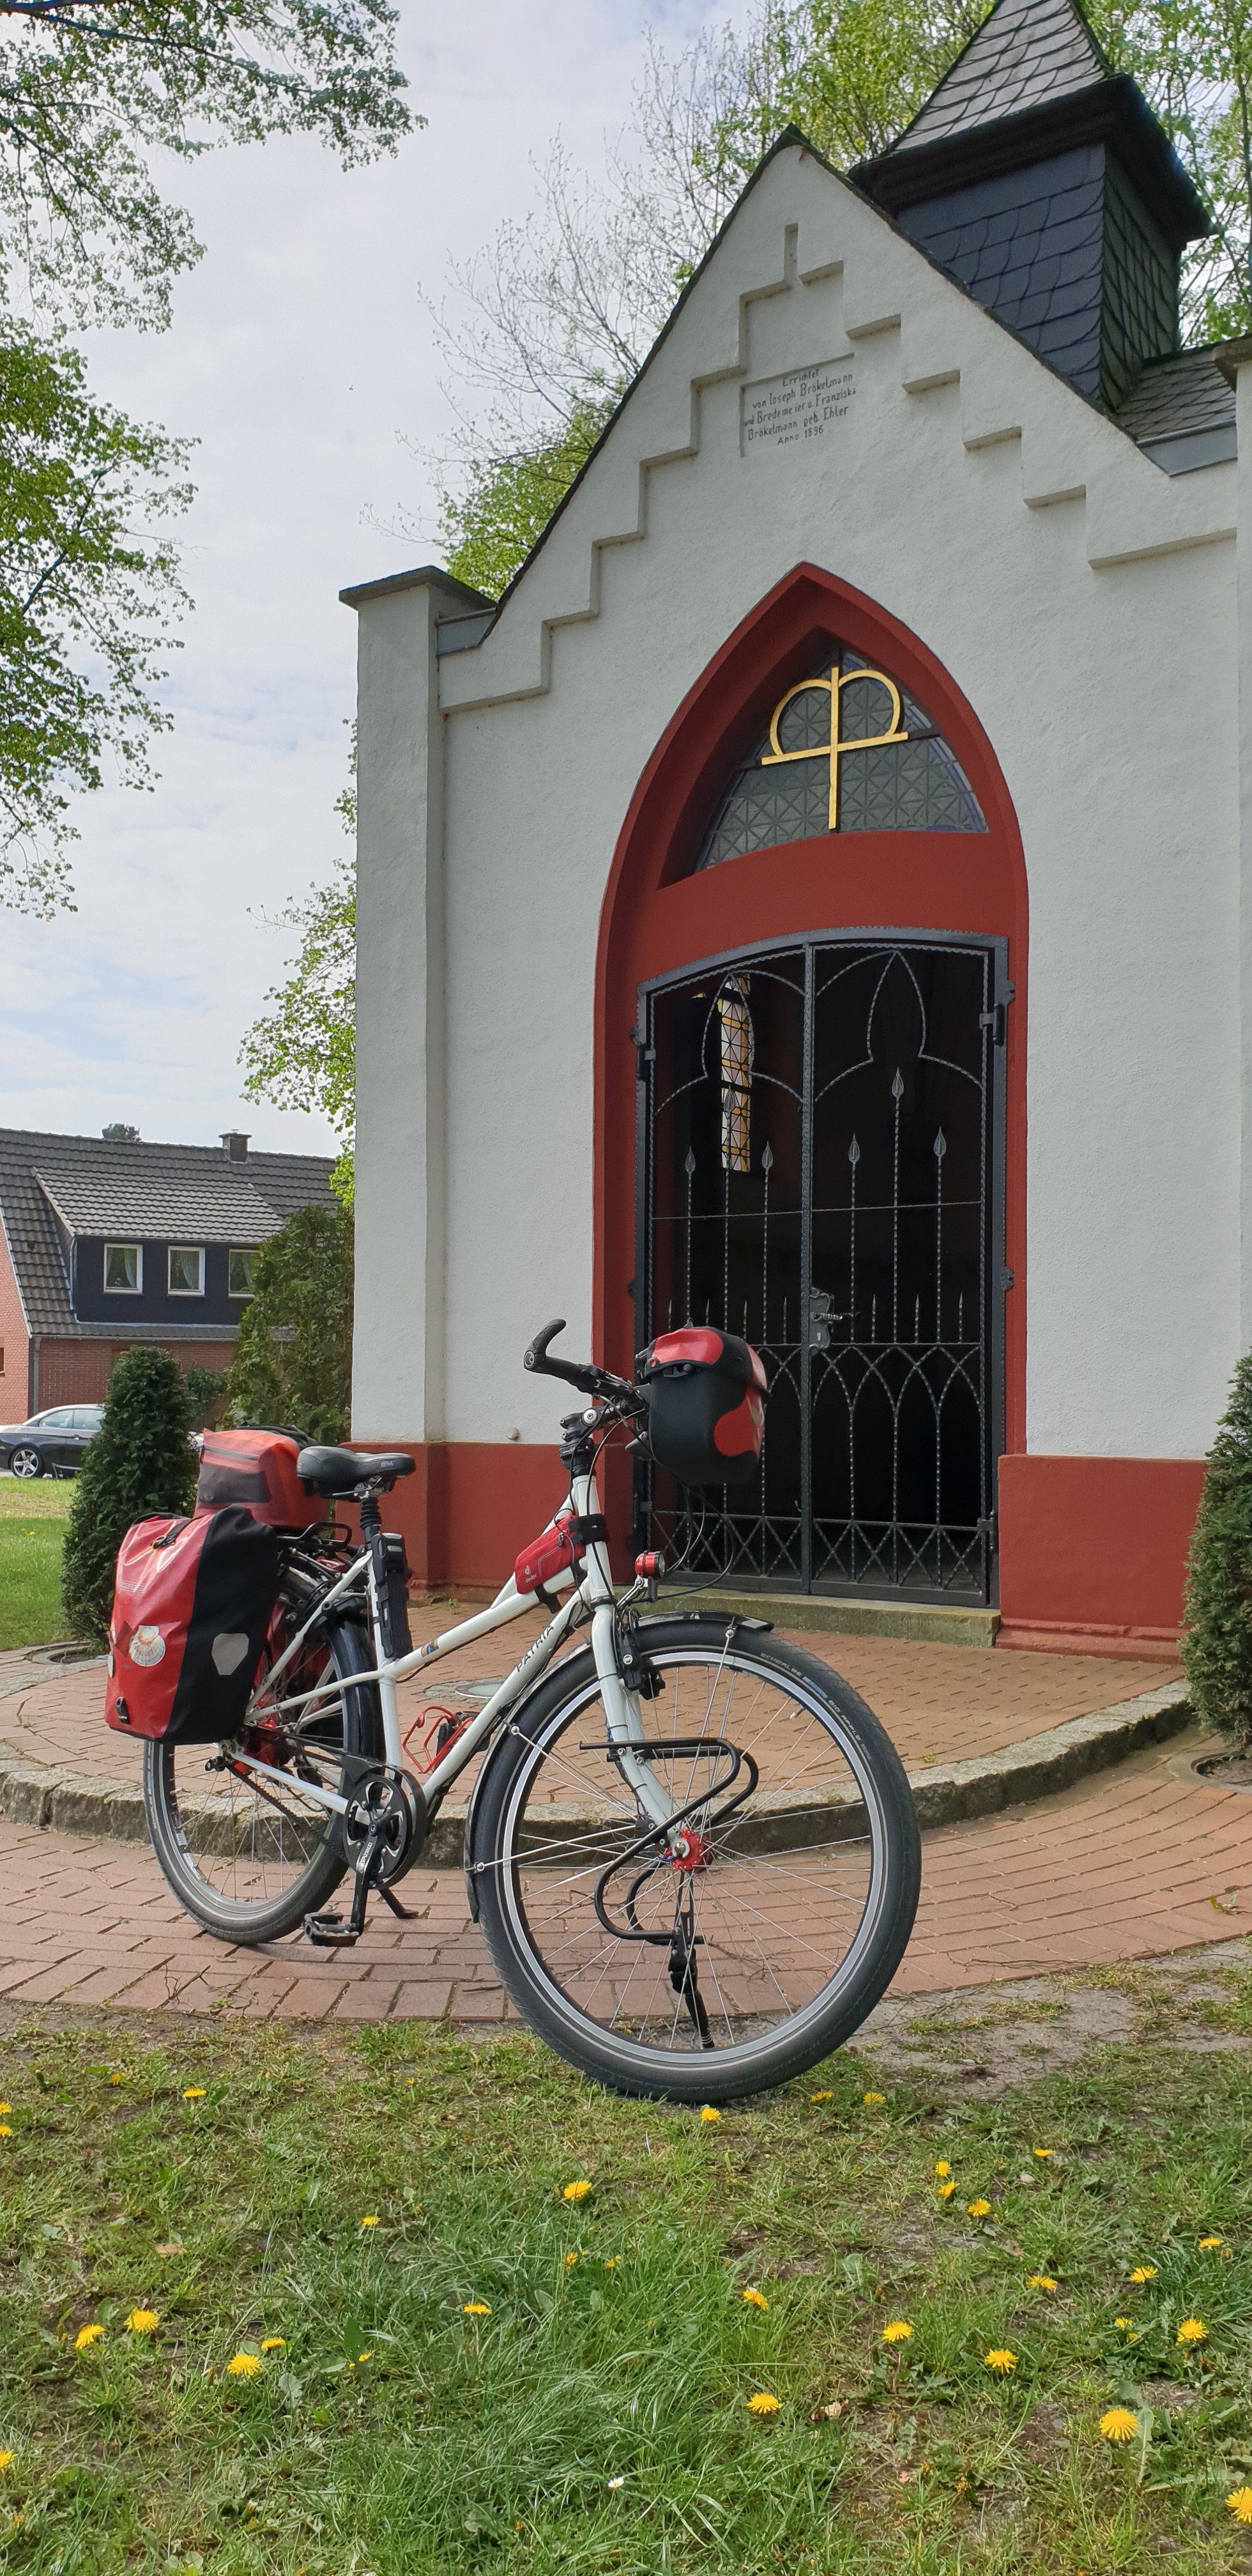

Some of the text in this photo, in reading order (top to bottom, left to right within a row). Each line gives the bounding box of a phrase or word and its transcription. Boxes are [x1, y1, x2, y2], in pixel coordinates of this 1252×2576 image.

[752, 400, 767, 409] von
[757, 402, 806, 425] Bredemeier
[816, 387, 857, 407] Franziska
[747, 421, 798, 441] Brökelmann
[823, 405, 849, 420] Ehler
[777, 424, 824, 445] Anno 1896
[760, 1652, 862, 1741] SCHWALBE BIG APPLE
